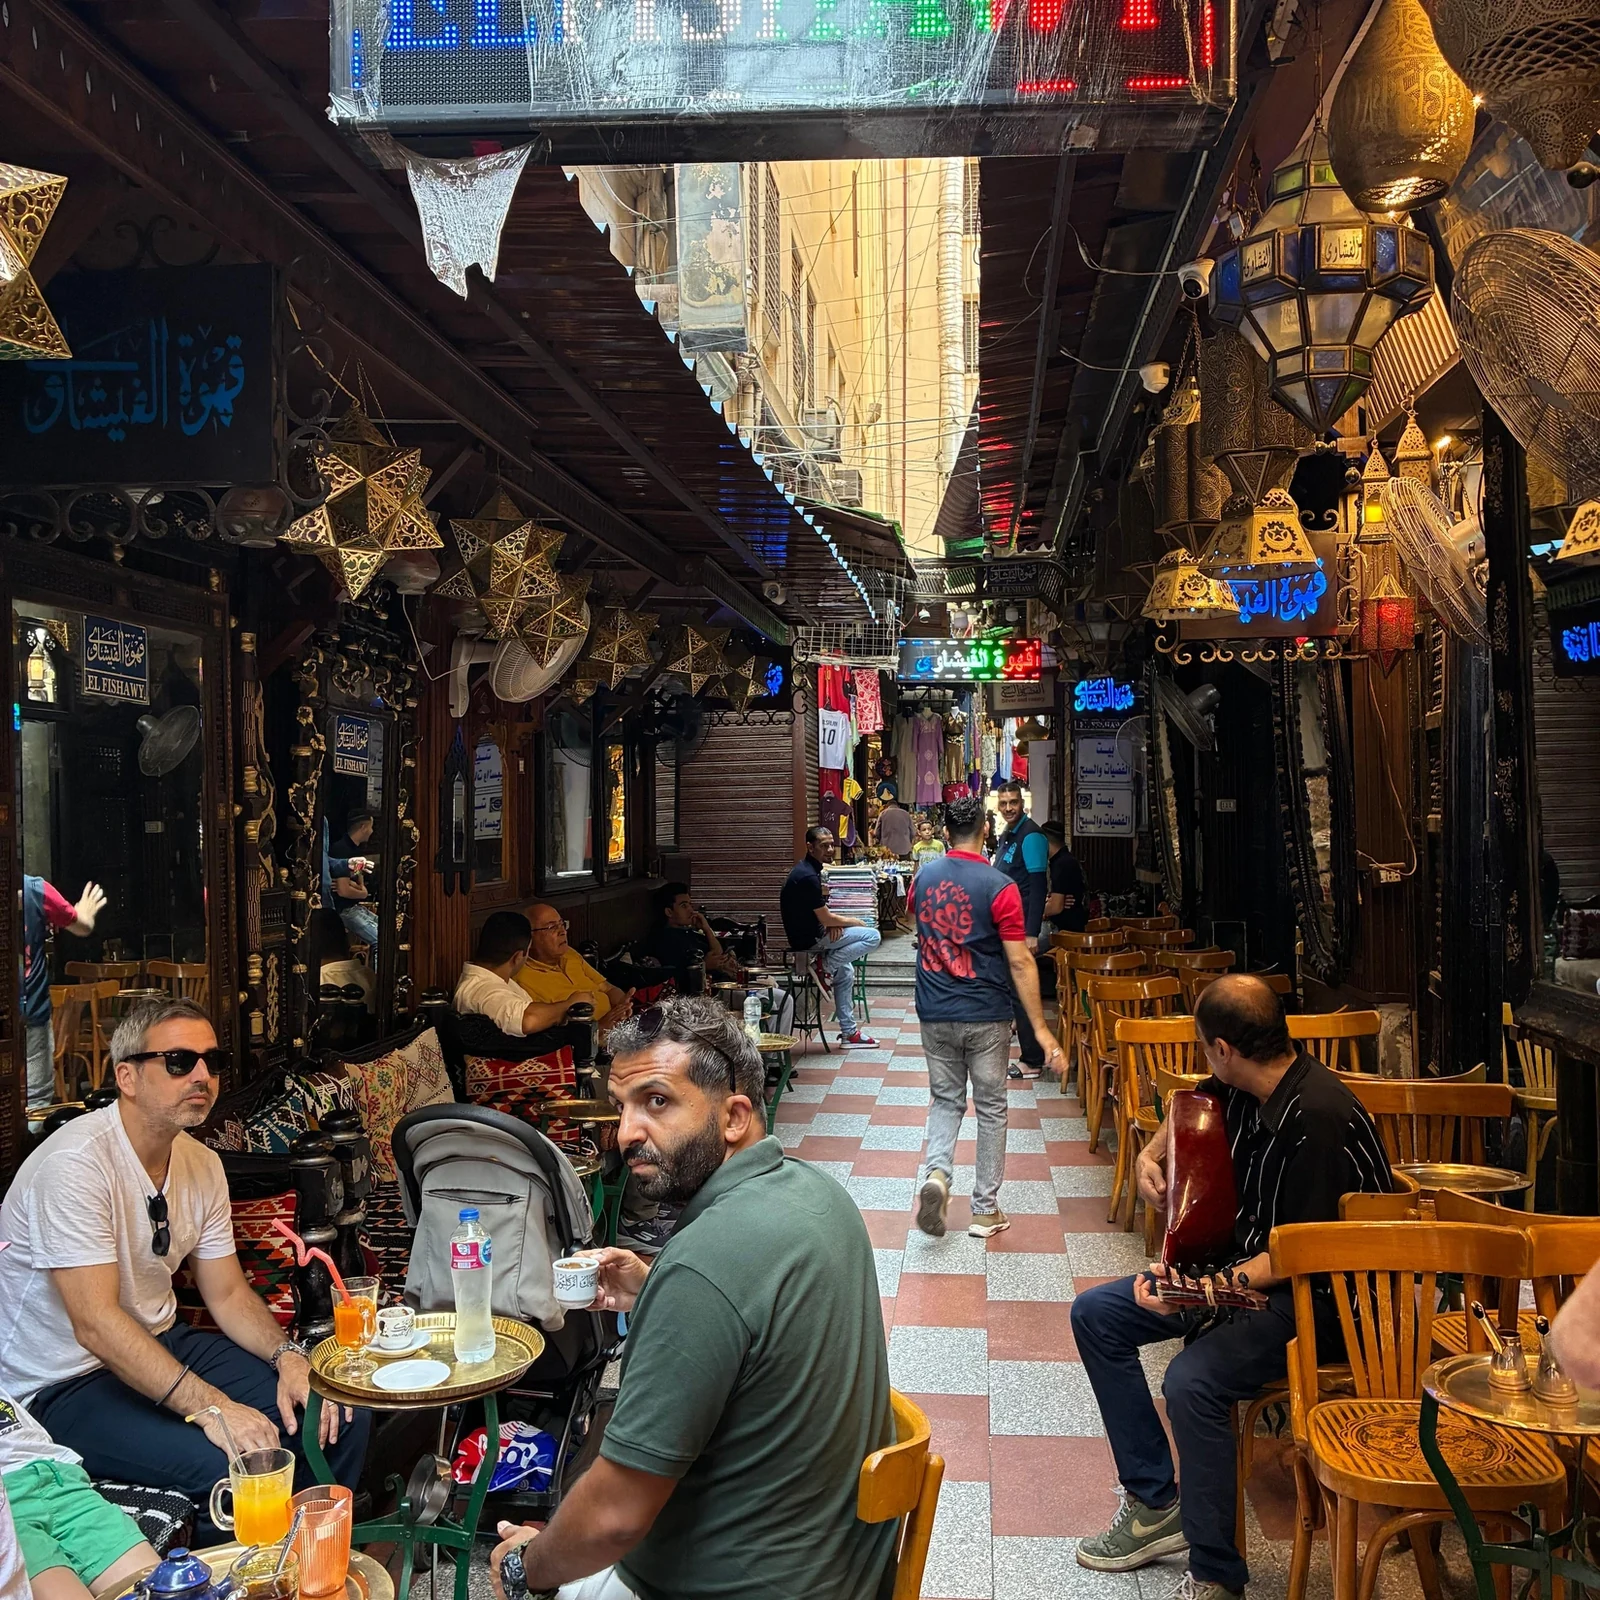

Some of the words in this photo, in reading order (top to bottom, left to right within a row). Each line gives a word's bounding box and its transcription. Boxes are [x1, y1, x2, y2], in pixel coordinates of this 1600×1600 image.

[87, 674, 101, 690] EL
[101, 677, 145, 699] FISHAWY
[821, 728, 836, 745] 10
[1096, 742, 1114, 758] بيت
[1096, 793, 1114, 808] بيت
